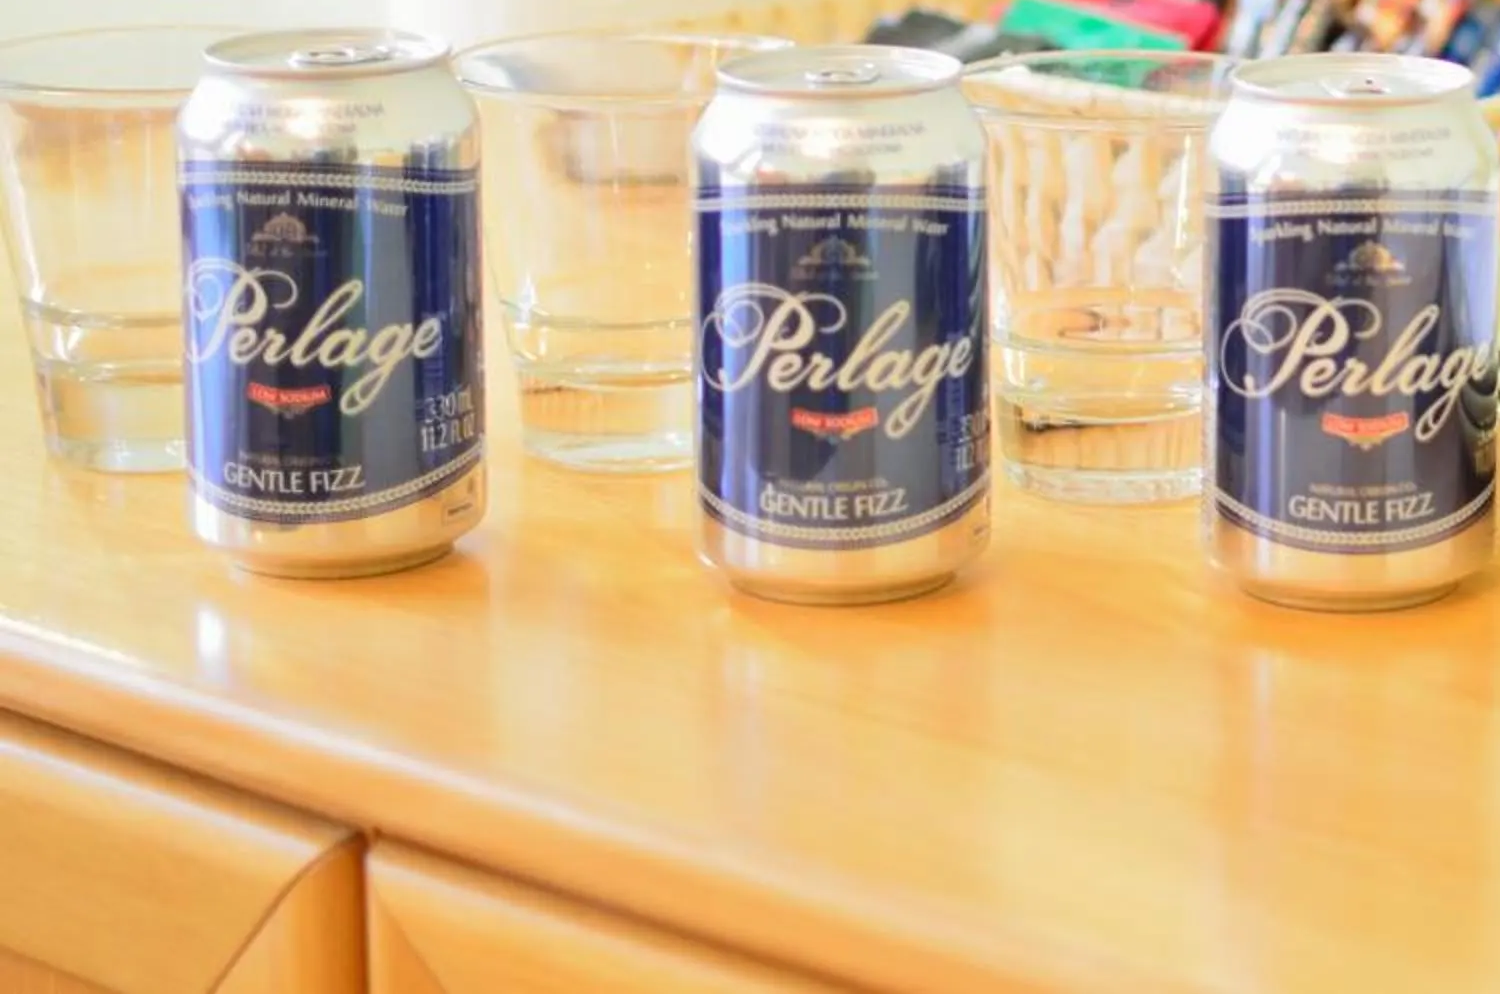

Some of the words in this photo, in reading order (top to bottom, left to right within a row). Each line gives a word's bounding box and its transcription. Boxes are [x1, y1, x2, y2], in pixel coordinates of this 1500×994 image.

[236, 189, 291, 206] Natural
[298, 191, 358, 210] Mineral
[781, 212, 841, 229] Natural
[1316, 217, 1377, 235] Natural
[184, 256, 443, 416] Perlage
[701, 282, 972, 440] Perlage
[1221, 287, 1488, 442] Perlage
[223, 461, 304, 494] GENTLE
[310, 465, 366, 492] FIZZ
[760, 488, 849, 520] GENTLE
[855, 487, 908, 518] FIZZ
[1288, 494, 1380, 524] GENTLE
[1385, 491, 1435, 522] FIZZ
